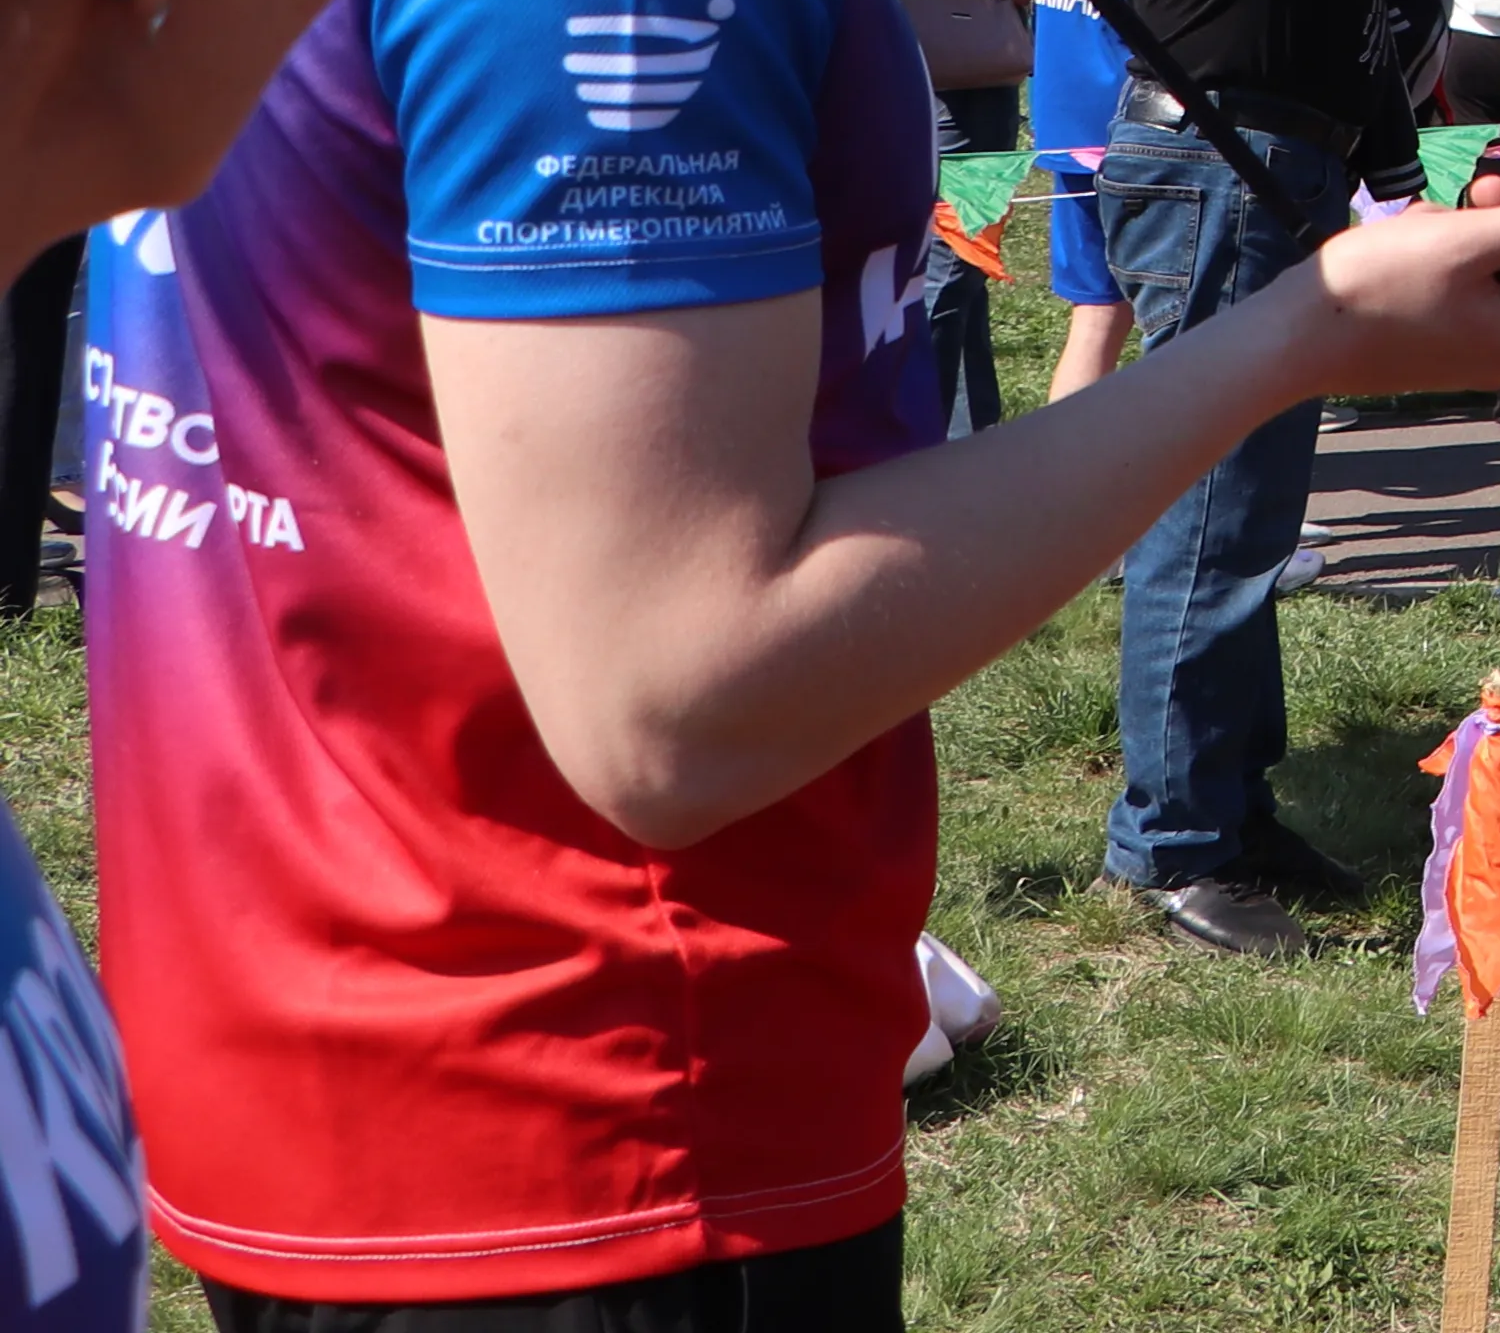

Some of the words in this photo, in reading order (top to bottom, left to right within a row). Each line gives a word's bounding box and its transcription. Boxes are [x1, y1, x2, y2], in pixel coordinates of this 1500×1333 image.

[534, 149, 740, 181] ФЕДЕРАЛЬНАЯ
[560, 183, 726, 214] ДИРЕКЦИЯ
[476, 201, 790, 245] СПОРТМЕРОПРИЯТИЙ
